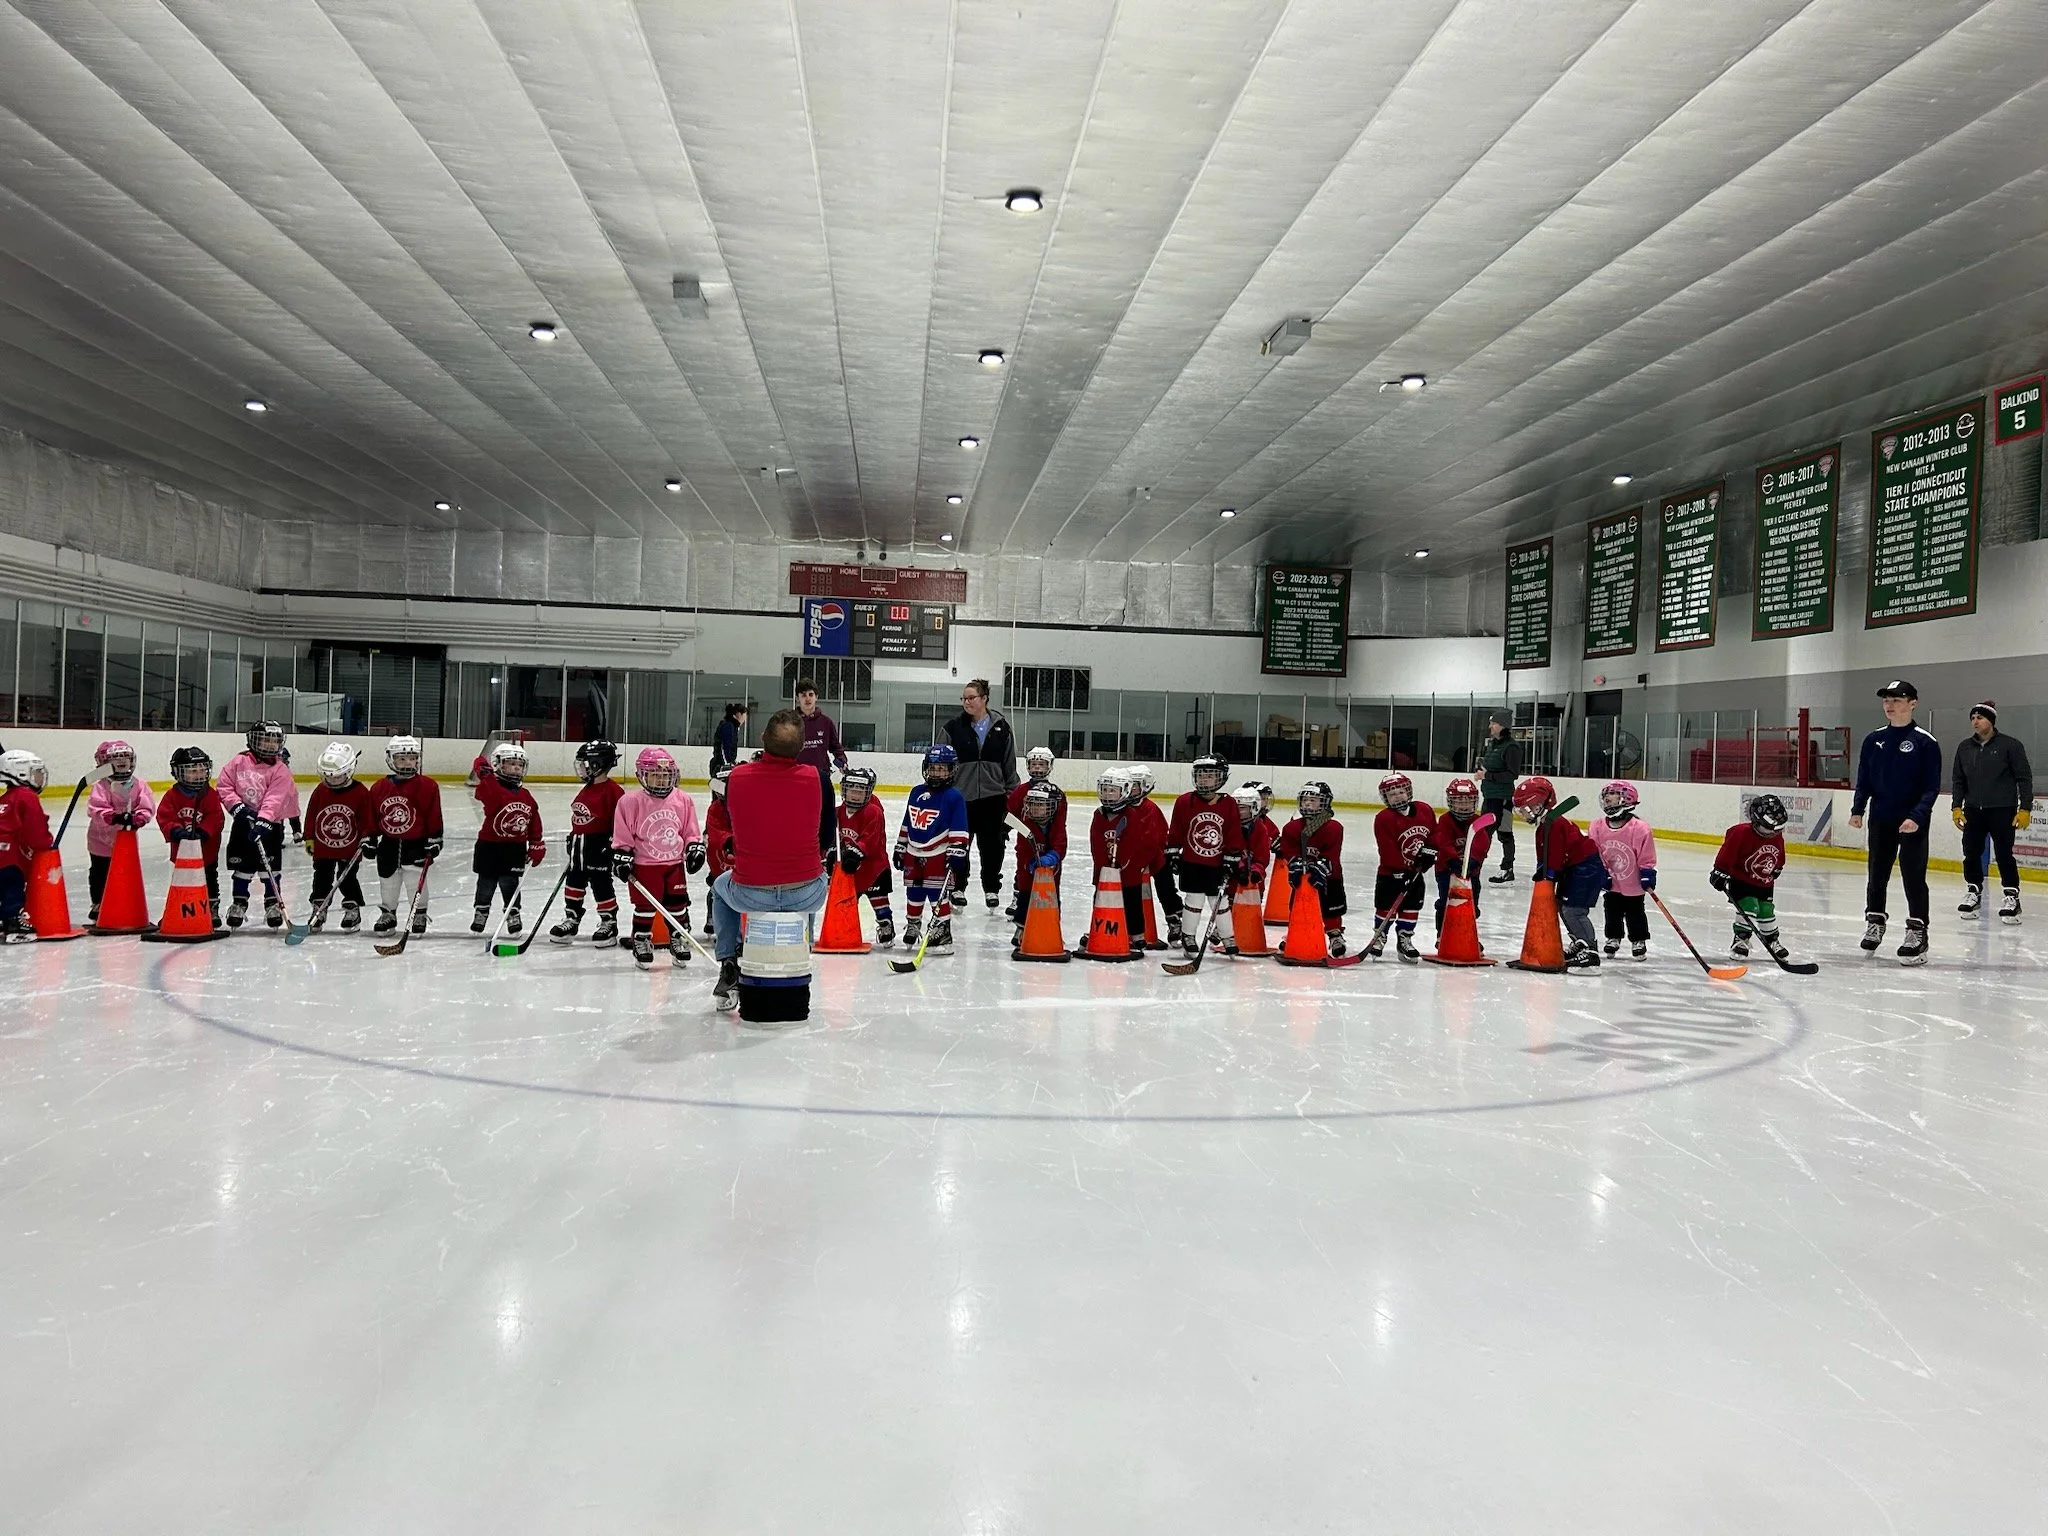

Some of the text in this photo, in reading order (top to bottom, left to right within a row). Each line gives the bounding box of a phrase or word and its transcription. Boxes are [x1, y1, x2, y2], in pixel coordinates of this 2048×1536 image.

[2000, 388, 2039, 410] BALKIND
[2014, 410, 2026, 430] 5
[1903, 424, 1950, 452] 2012-2013
[1886, 443, 1967, 474] NEW CANAAN WINTER CLUB
[1915, 463, 1935, 476] MITE A
[1778, 464, 1814, 487] 2016-2017
[1886, 467, 1966, 498] TIER II CONNECTICUT
[1884, 481, 1965, 513] STATE CHAMPIONS
[839, 568, 859, 576] HOME
[1290, 574, 1327, 584] 2022-2023
[810, 604, 823, 648] PEPSI
[648, 810, 680, 822] RISING
